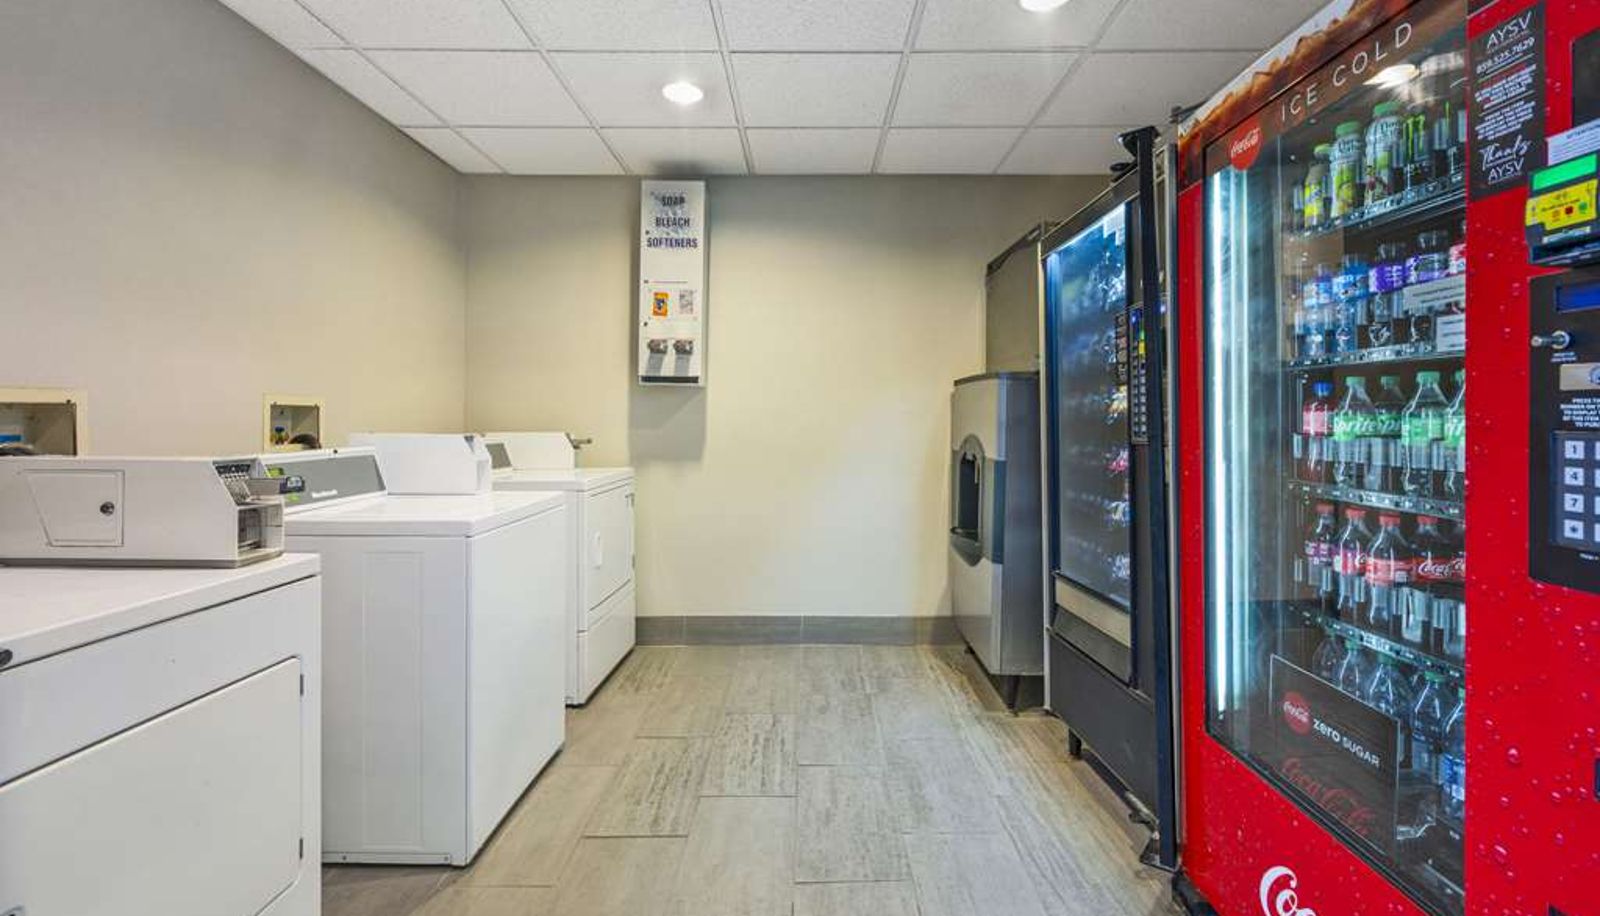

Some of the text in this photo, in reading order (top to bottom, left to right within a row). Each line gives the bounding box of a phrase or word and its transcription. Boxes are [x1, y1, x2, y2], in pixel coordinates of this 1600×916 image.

[1487, 10, 1532, 49] AYSV
[1282, 22, 1412, 121] ICE COLD
[1488, 157, 1524, 183] AYSV
[662, 196, 685, 207] SOAP
[656, 217, 690, 228] BLEACH
[646, 238, 698, 249] SOFTENERS
[1572, 444, 1577, 454] 1
[1569, 471, 1578, 481] 4
[1570, 498, 1578, 508] 7
[1312, 718, 1380, 769] zero SUGAR
